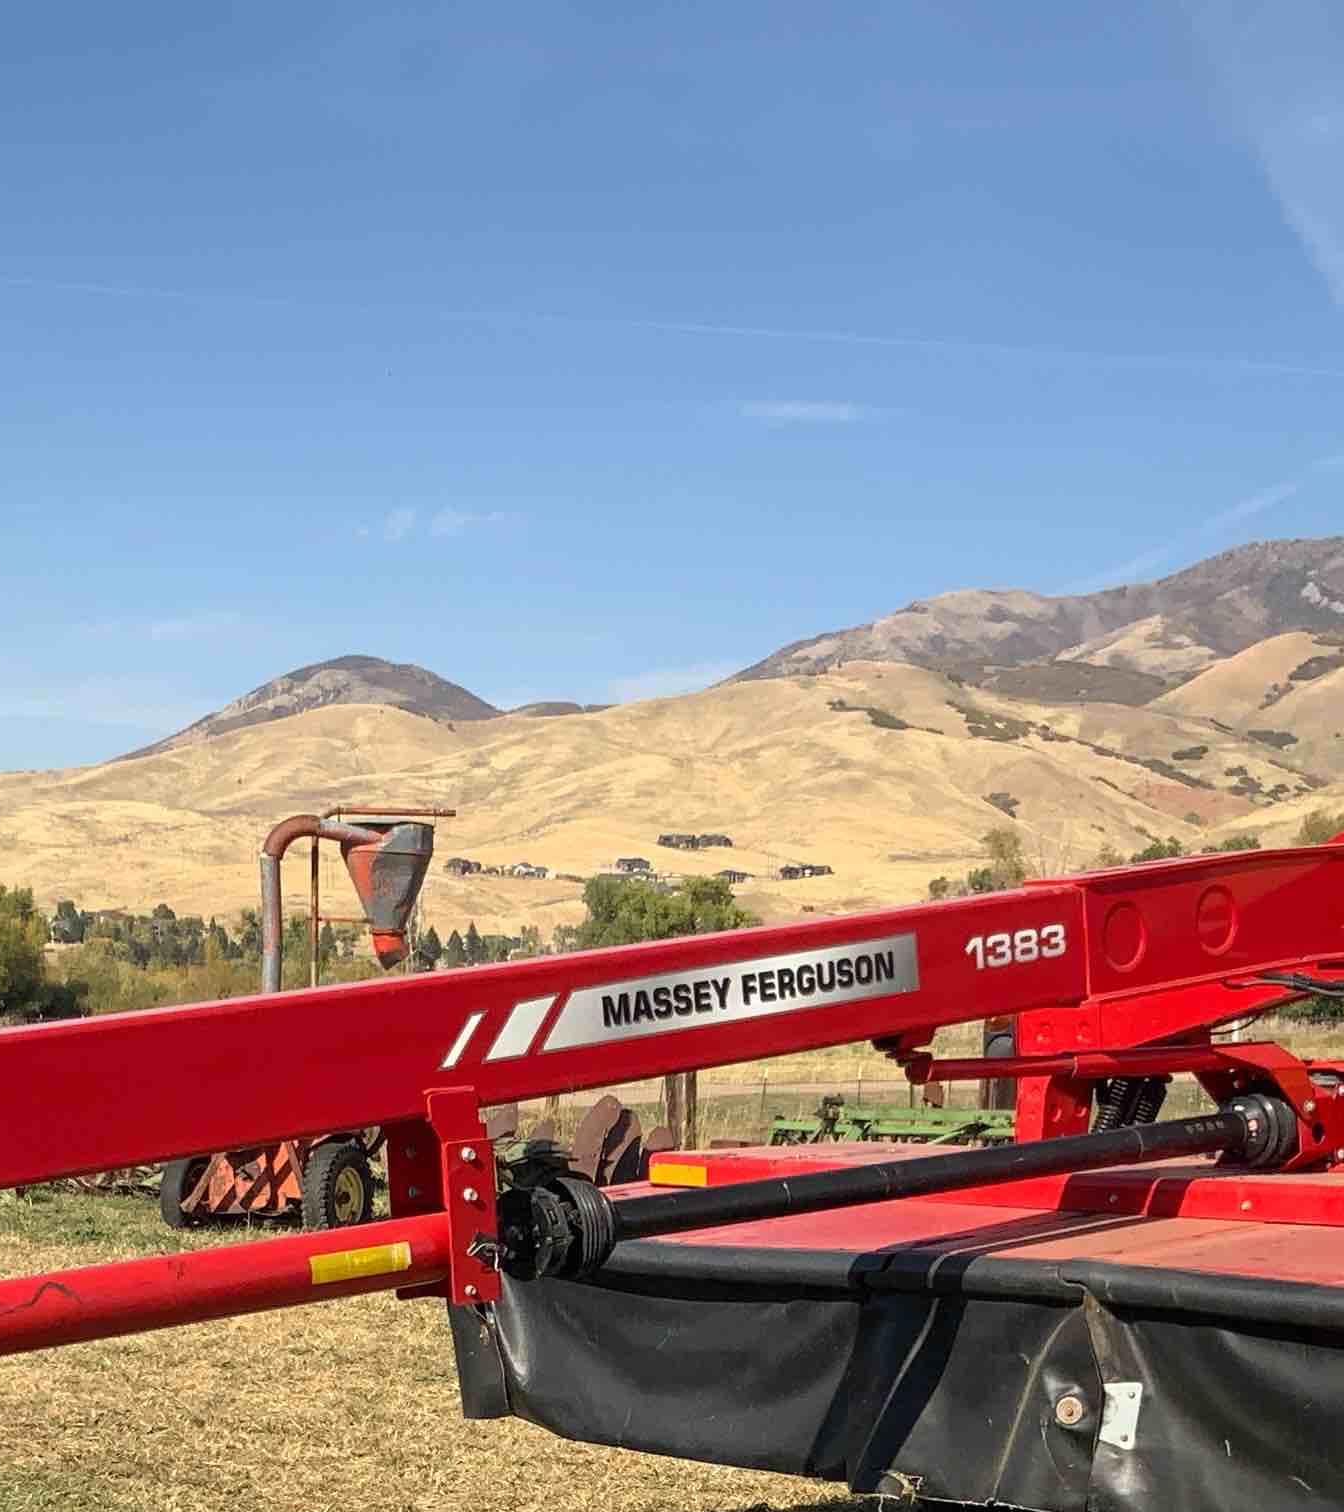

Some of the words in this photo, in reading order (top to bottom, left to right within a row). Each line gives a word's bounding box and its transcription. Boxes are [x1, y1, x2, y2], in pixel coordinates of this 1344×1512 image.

[965, 923, 1067, 970] 1383
[601, 977, 732, 1028] MASSEY
[741, 951, 895, 1006] FERGUSON
